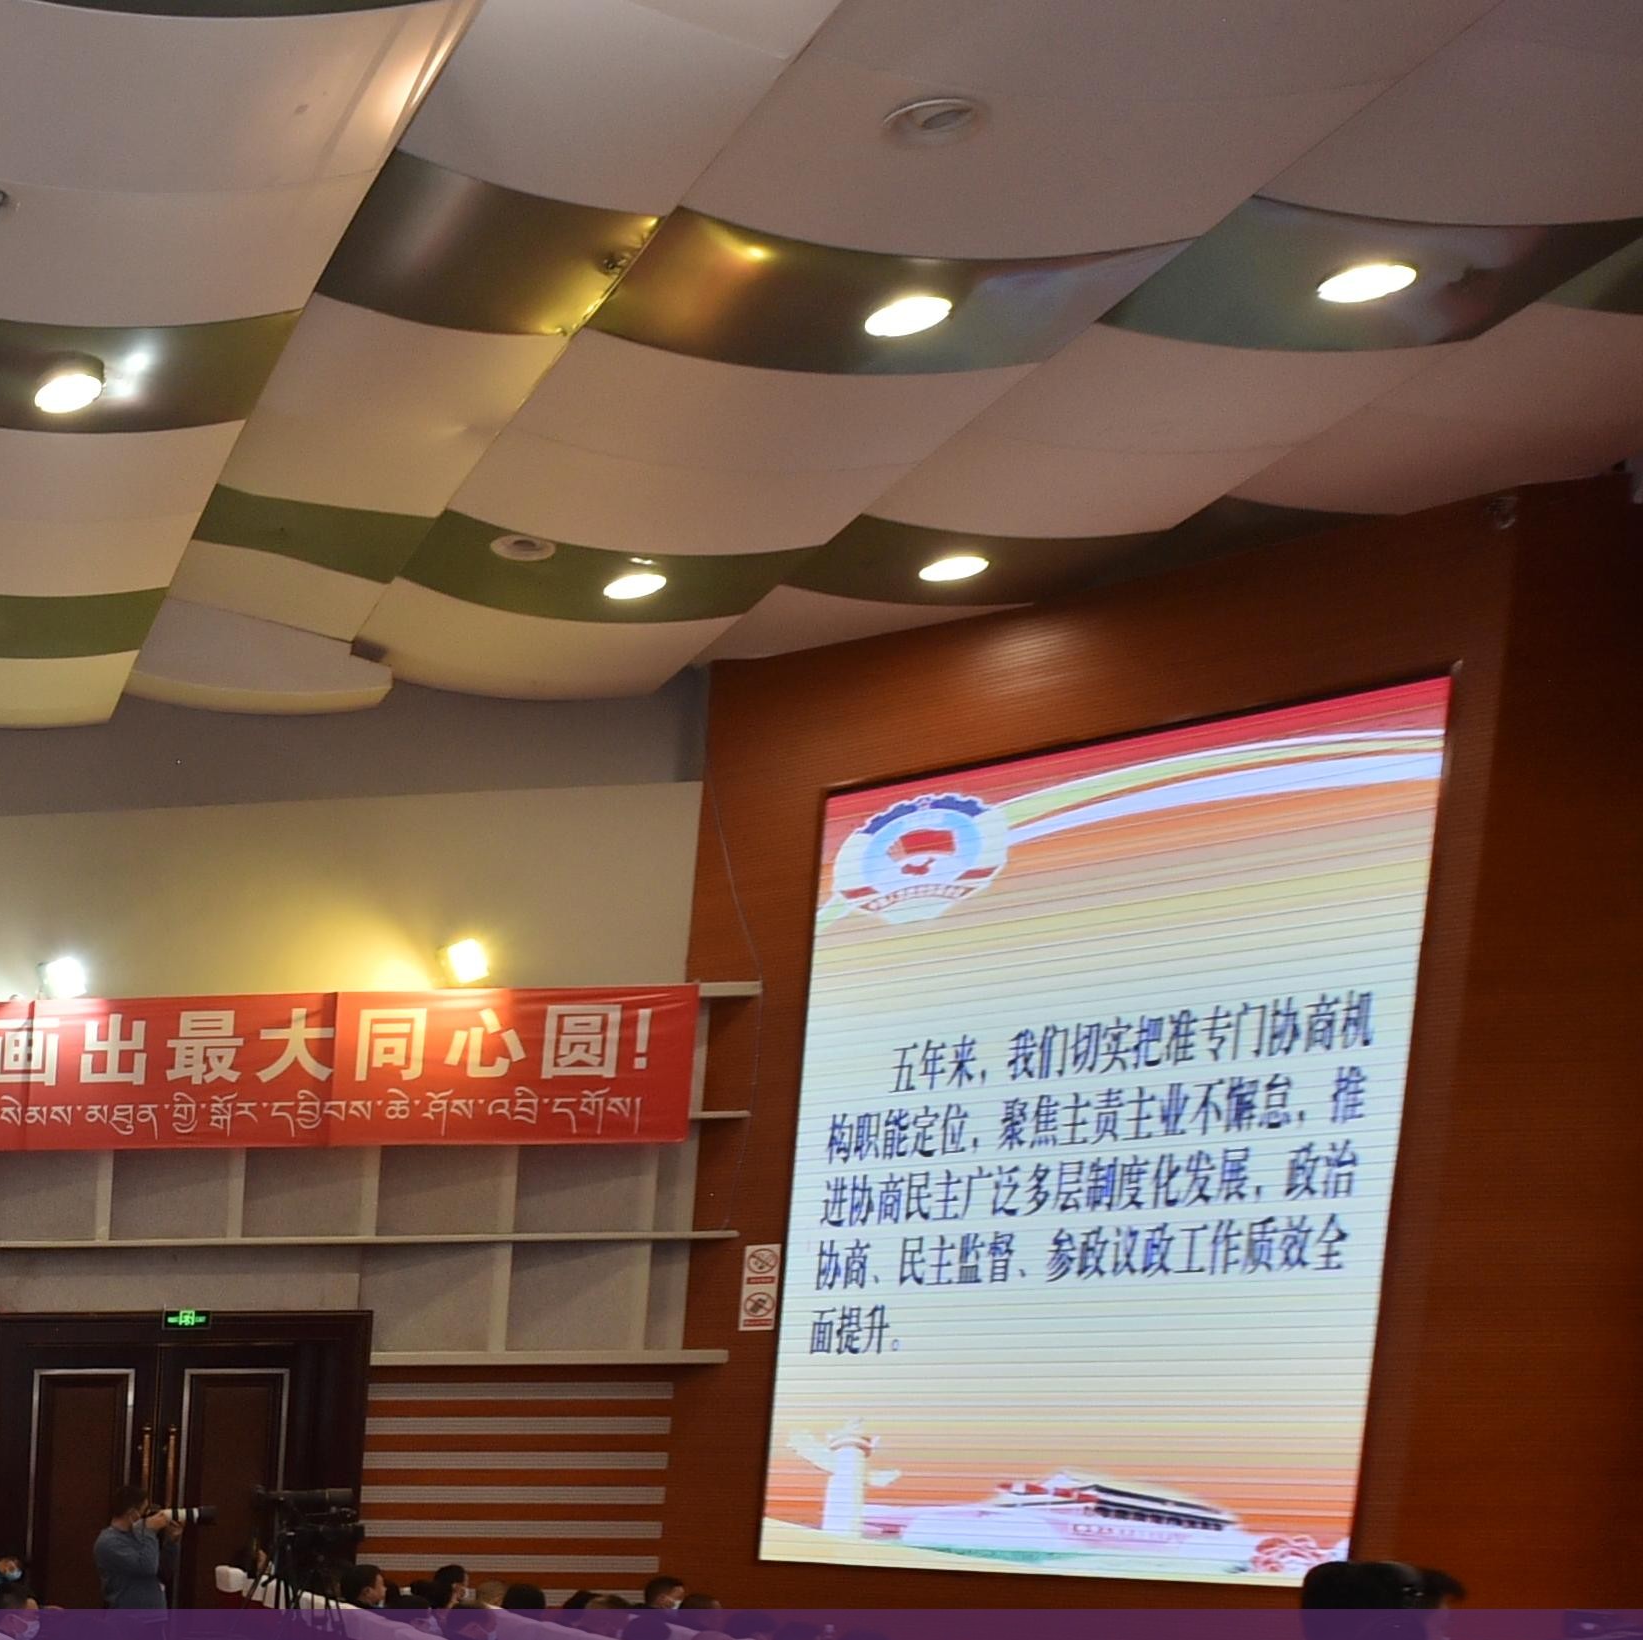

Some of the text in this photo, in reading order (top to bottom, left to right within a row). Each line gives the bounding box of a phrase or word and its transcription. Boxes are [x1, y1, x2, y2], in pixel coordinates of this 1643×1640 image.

[889, 990, 1374, 1094] 五年来，我们切实把准专门协商机
[827, 1065, 1367, 1165] 构职能定位，聚焦主责主业不懈怠，推
[820, 1139, 1359, 1229] 进协商民主广泛多层制度化发展，政治
[815, 1213, 1349, 1292] 协商、民主监督、参政议政工作质效全
[809, 1303, 903, 1356] 面提升。
